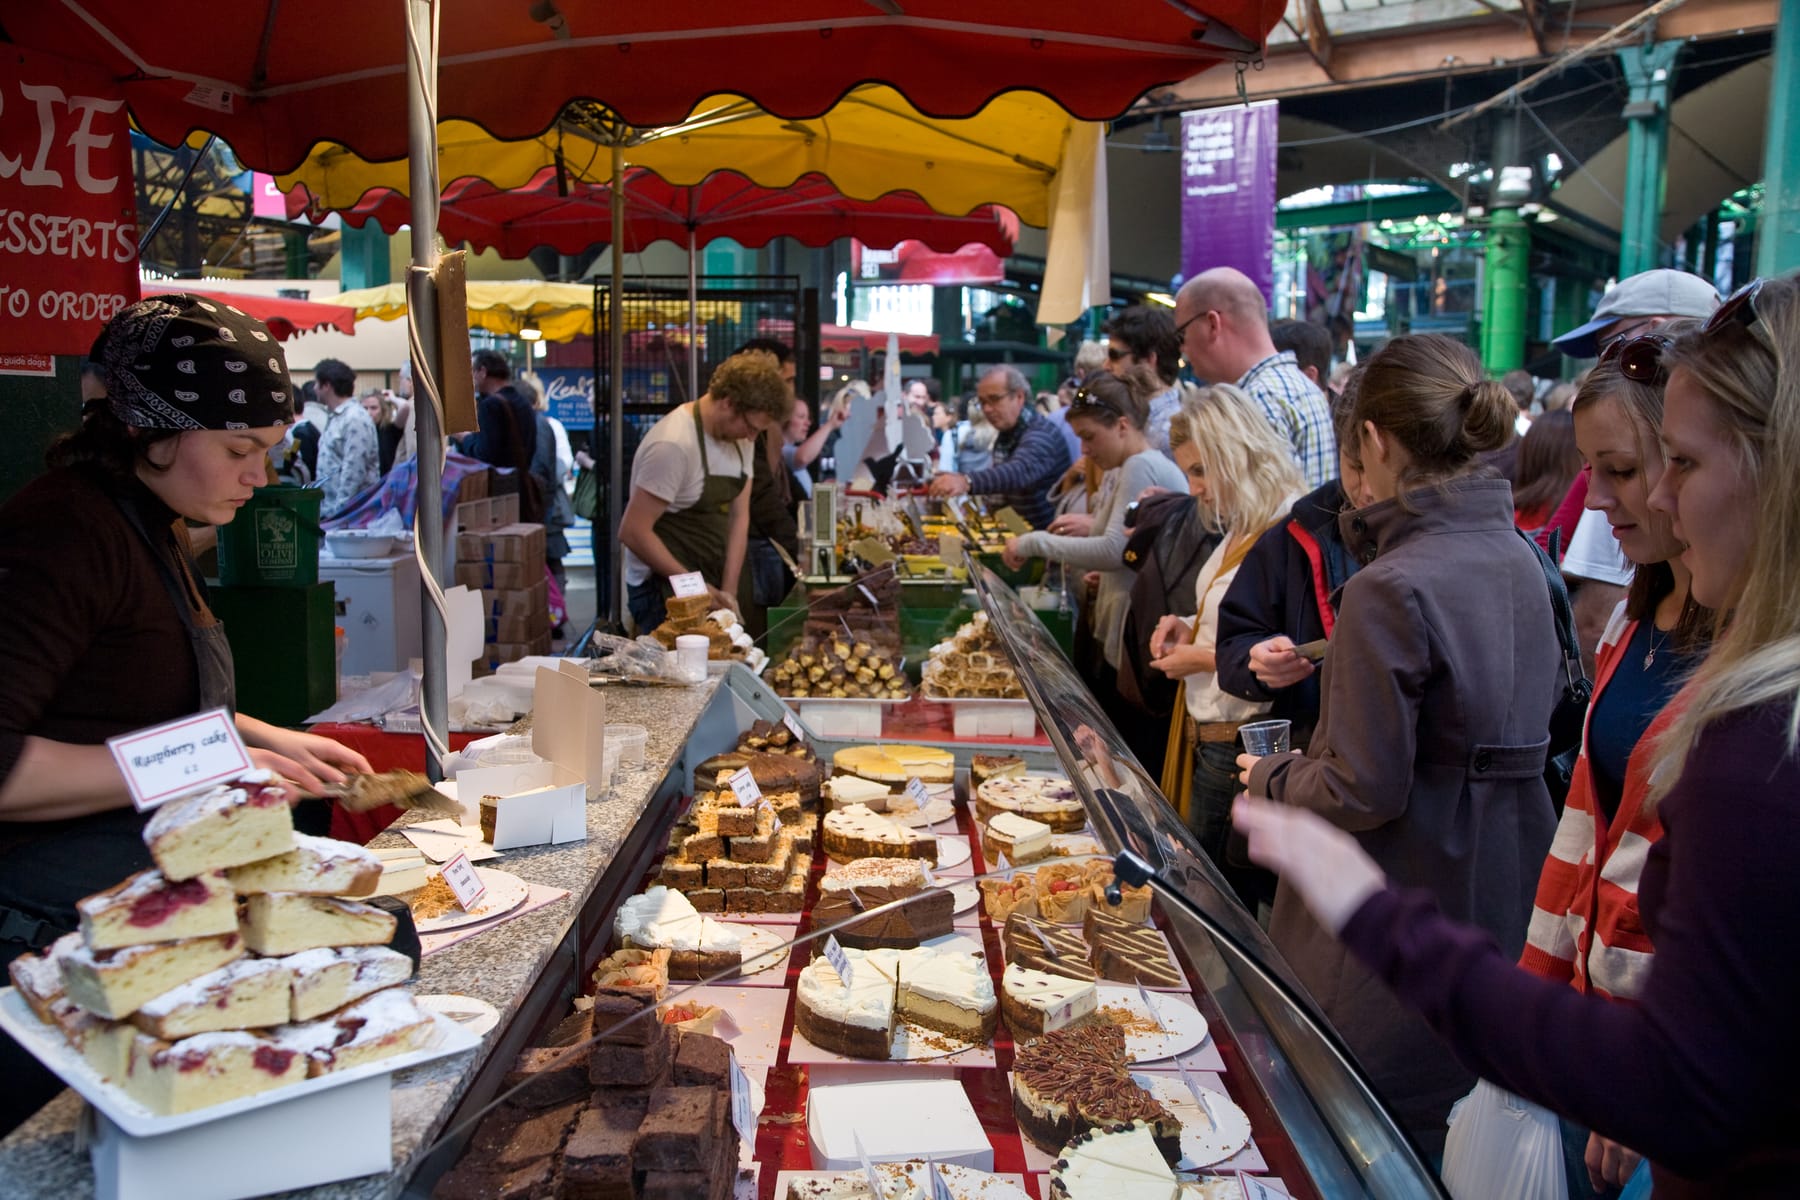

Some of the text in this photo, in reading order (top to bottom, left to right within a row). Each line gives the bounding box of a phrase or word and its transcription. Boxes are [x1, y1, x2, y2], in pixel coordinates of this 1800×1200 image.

[38, 290, 127, 321] ORDER
[261, 549, 294, 559] OLIVE
[132, 730, 229, 767] Raspberry cake
